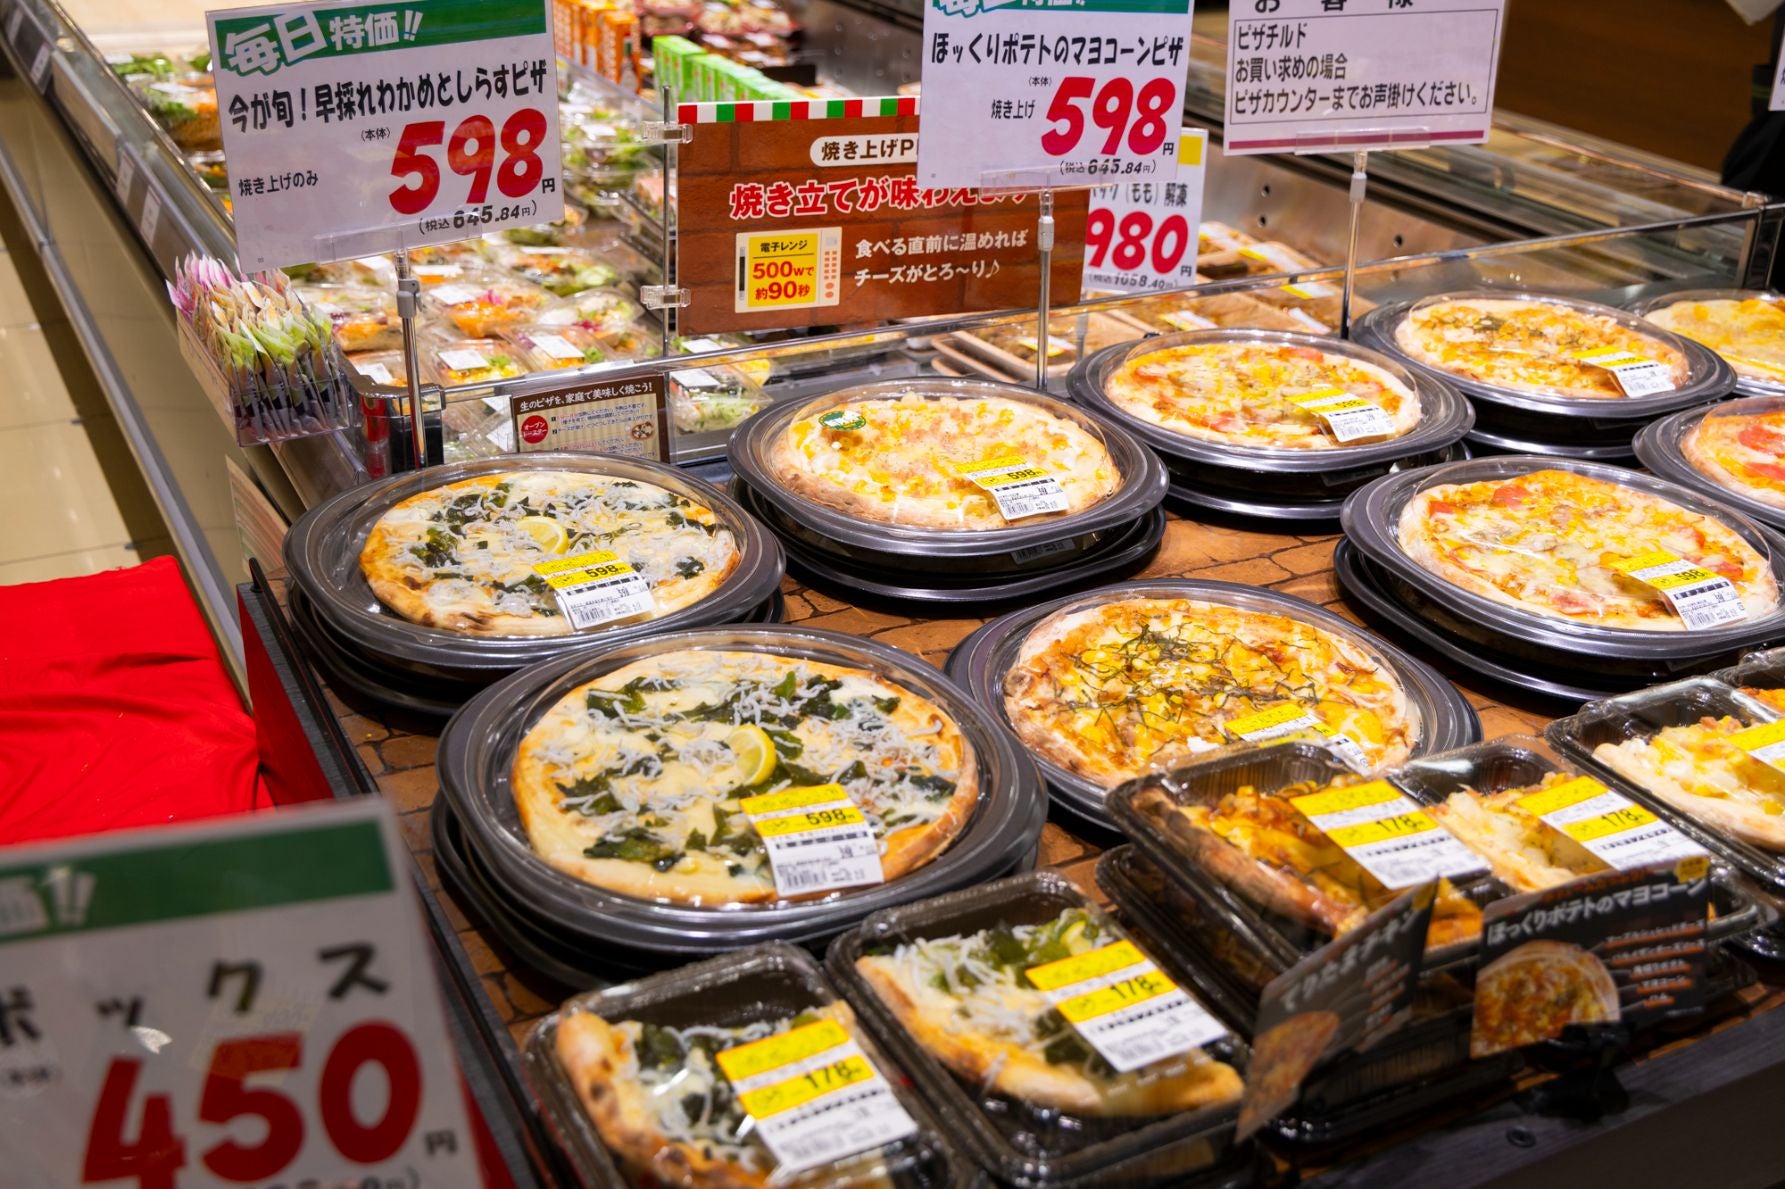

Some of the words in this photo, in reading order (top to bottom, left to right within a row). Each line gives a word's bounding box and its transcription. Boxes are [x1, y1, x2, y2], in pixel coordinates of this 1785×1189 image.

[1238, 23, 1307, 50] ピザチルド
[1236, 53, 1348, 83] お買い求めの場合
[228, 59, 547, 133] 今が旬！早採れわかめとしらすピザ
[1235, 80, 1478, 115] ピザカウンターまでお声掛けください。
[991, 99, 1035, 119] 焼き上げ
[238, 169, 319, 197] 焼き上げのみ
[760, 240, 808, 253] 電子レンジ
[855, 229, 1029, 259] 食べる直前に温めれば
[755, 280, 811, 301] 約90秒
[1007, 469, 1036, 480] 598
[585, 565, 618, 578] 598
[805, 808, 847, 825] 598
[1601, 808, 1638, 827] 178
[1109, 975, 1153, 1000] 178
[804, 1061, 850, 1088] 178
